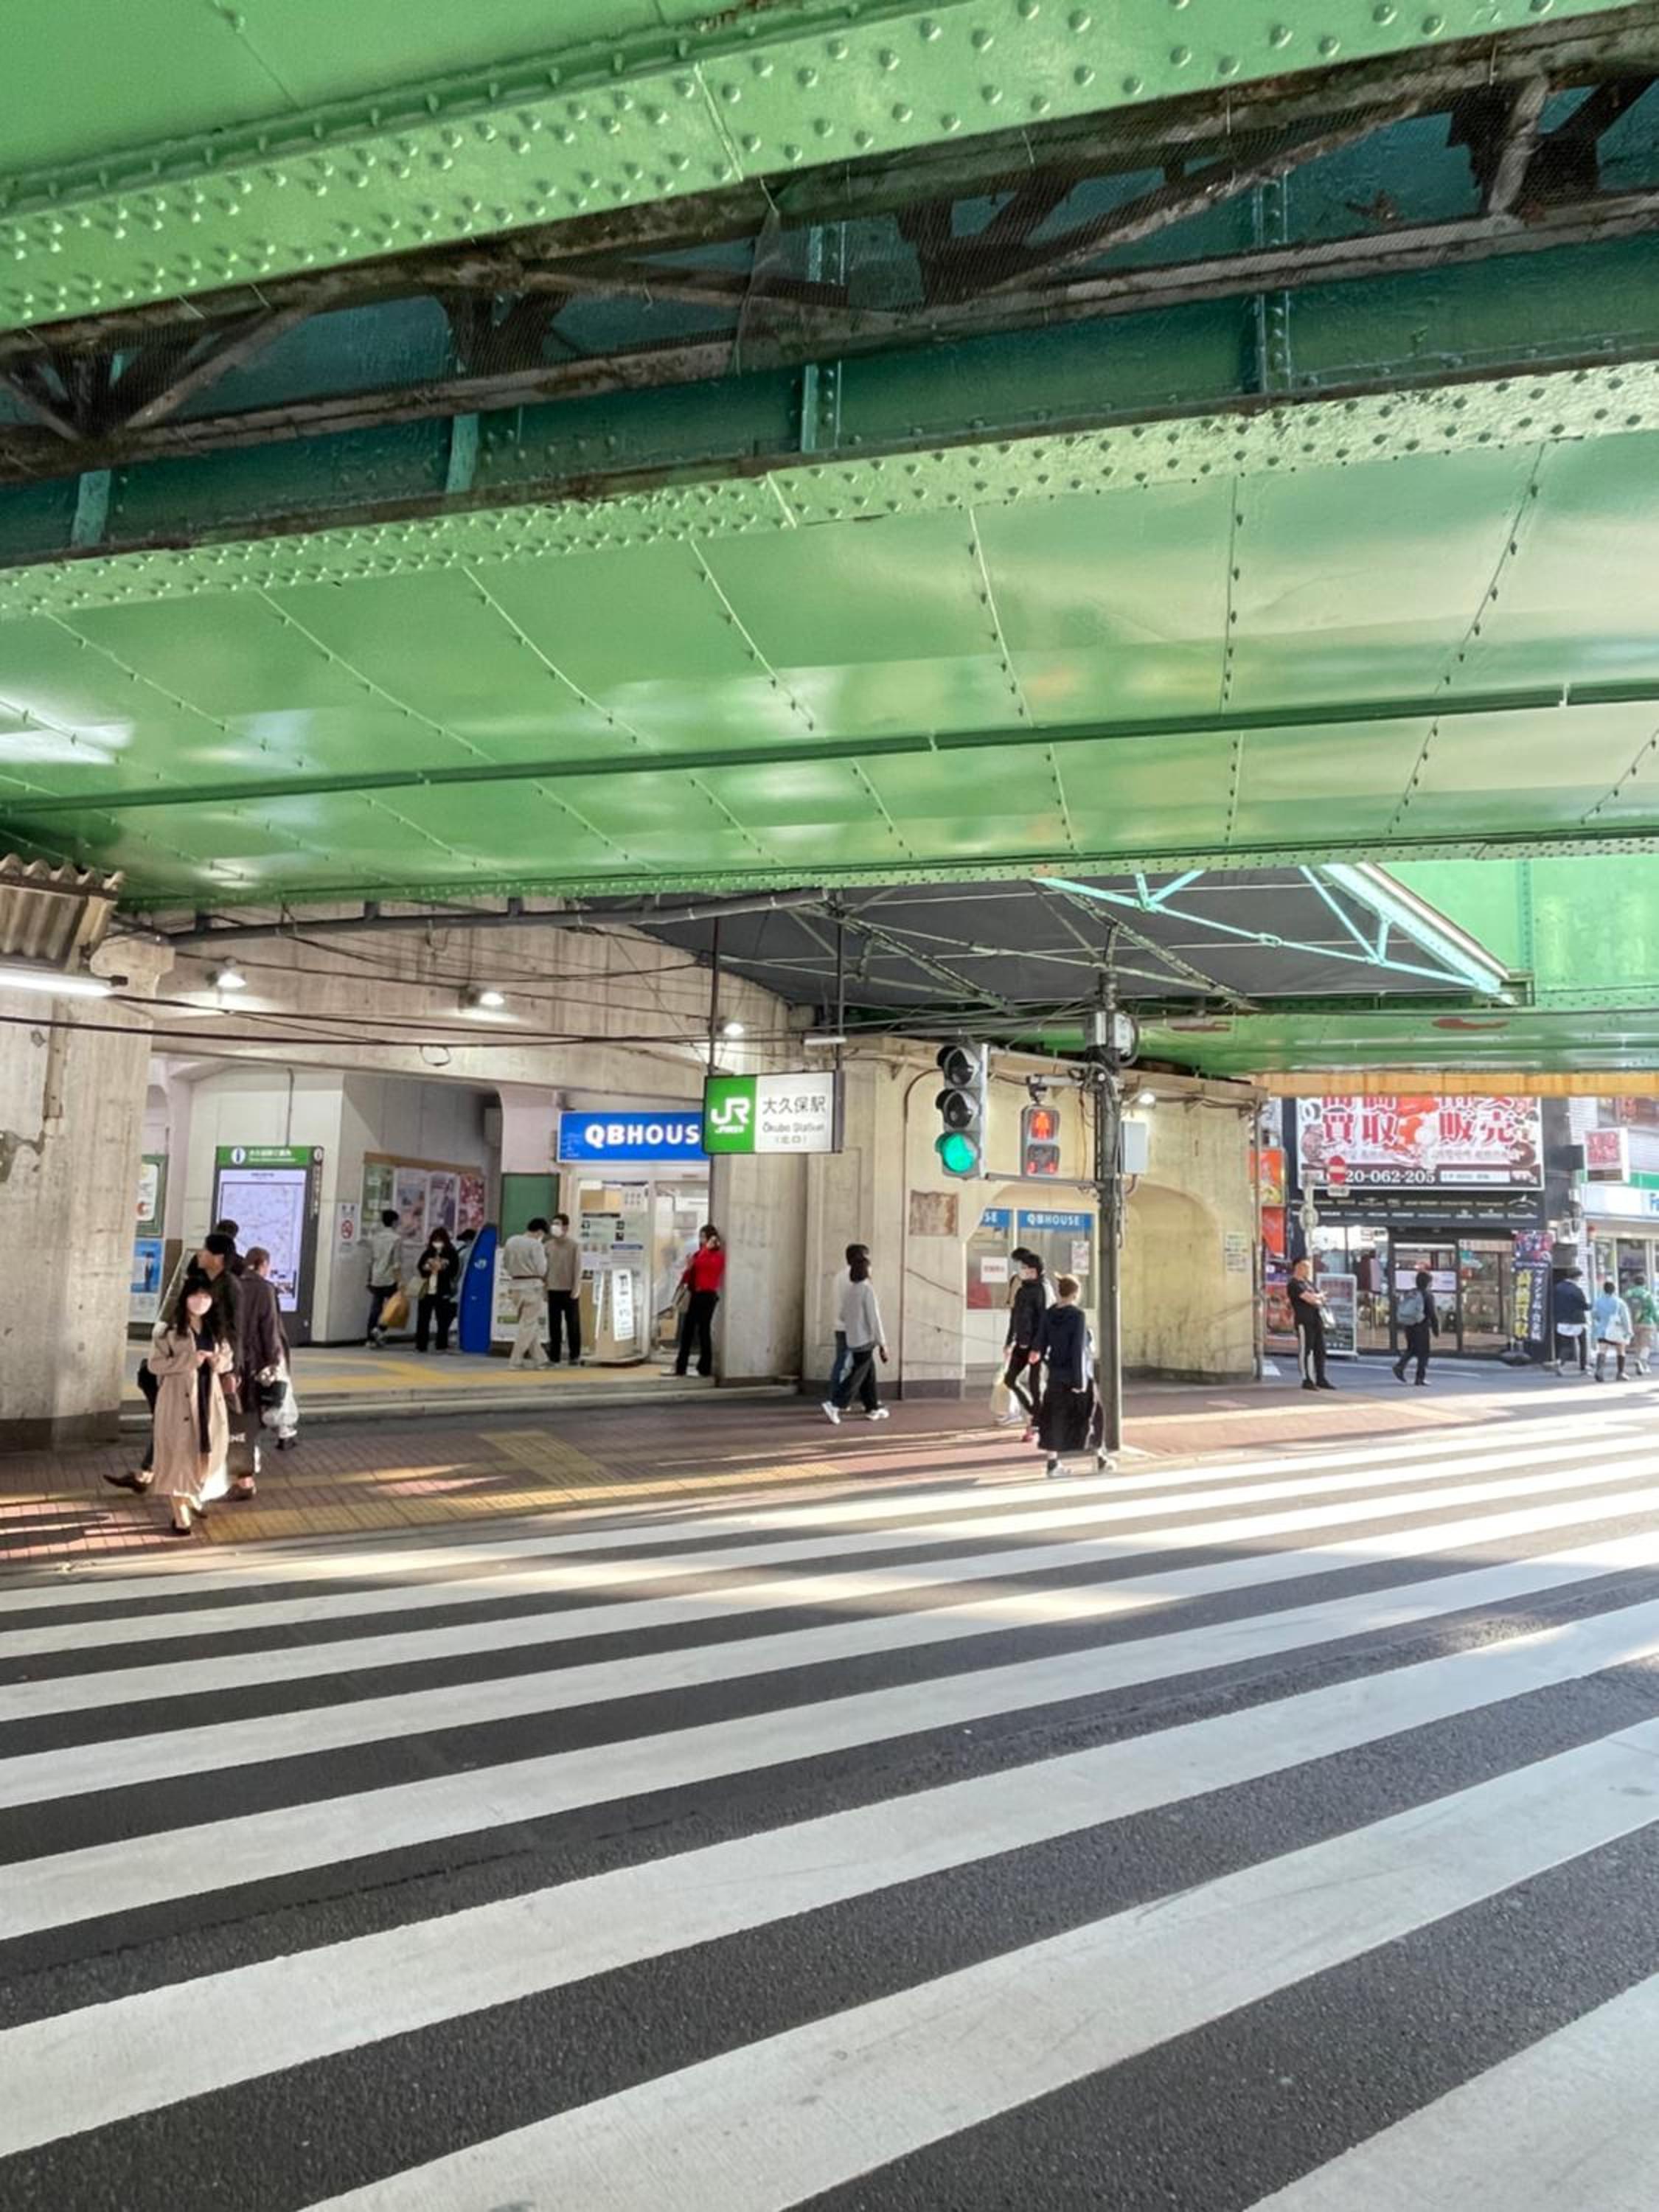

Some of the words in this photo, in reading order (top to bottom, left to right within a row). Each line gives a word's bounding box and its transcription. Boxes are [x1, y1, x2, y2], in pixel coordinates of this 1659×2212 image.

[710, 1097, 750, 1125] JR
[762, 1096, 827, 1115] 大久保駅
[584, 1124, 700, 1149] QBHOUS
[1326, 1169, 1435, 1184] 20-062-205
[1027, 1213, 1080, 1226] QBHOUSE
